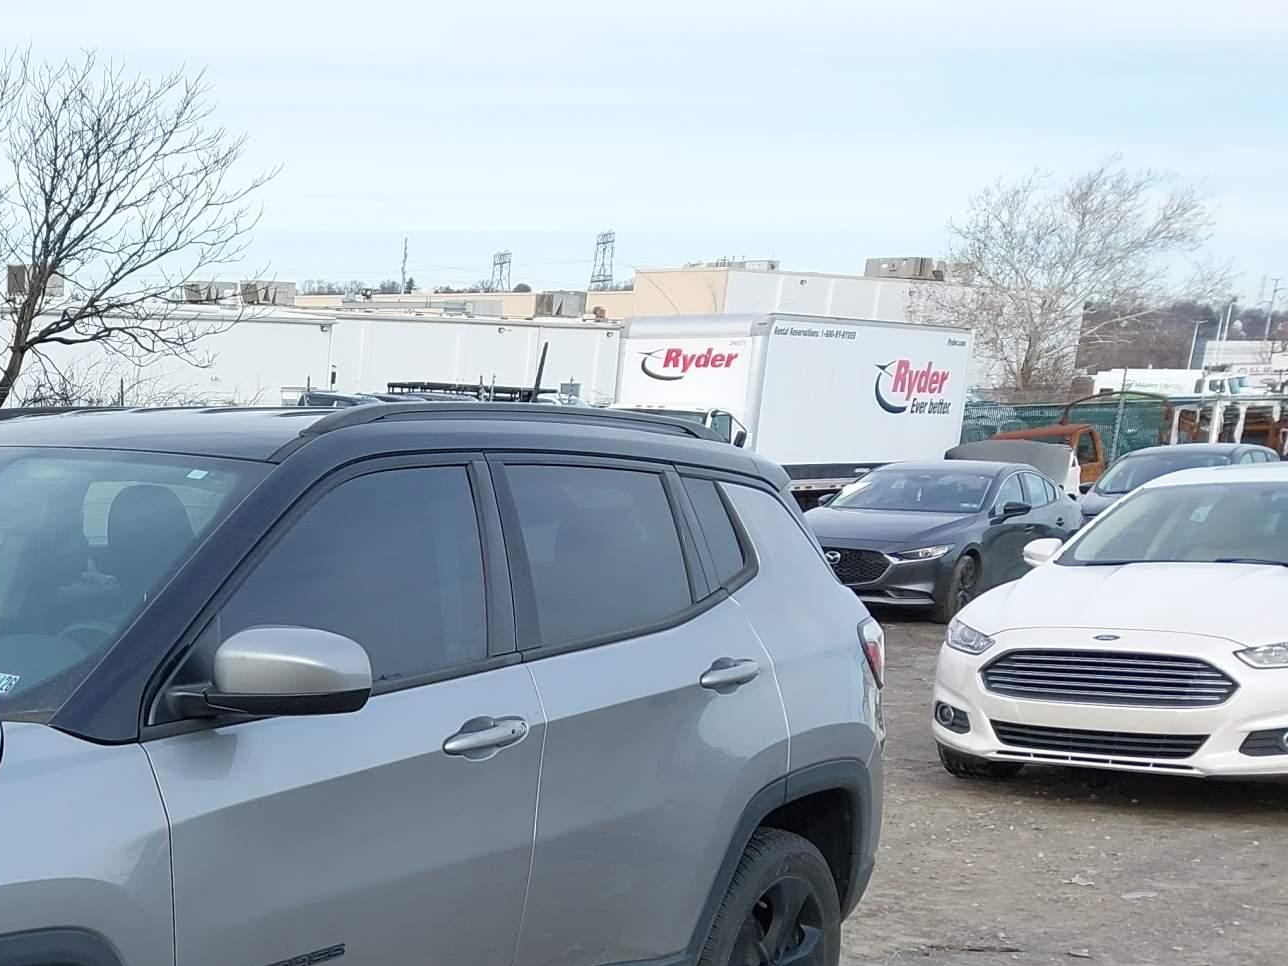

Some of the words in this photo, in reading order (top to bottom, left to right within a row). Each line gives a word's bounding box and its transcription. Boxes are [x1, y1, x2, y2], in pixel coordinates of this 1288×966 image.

[662, 347, 739, 373] Ryder
[891, 359, 950, 401] Ryder
[910, 398, 928, 414] Ever
